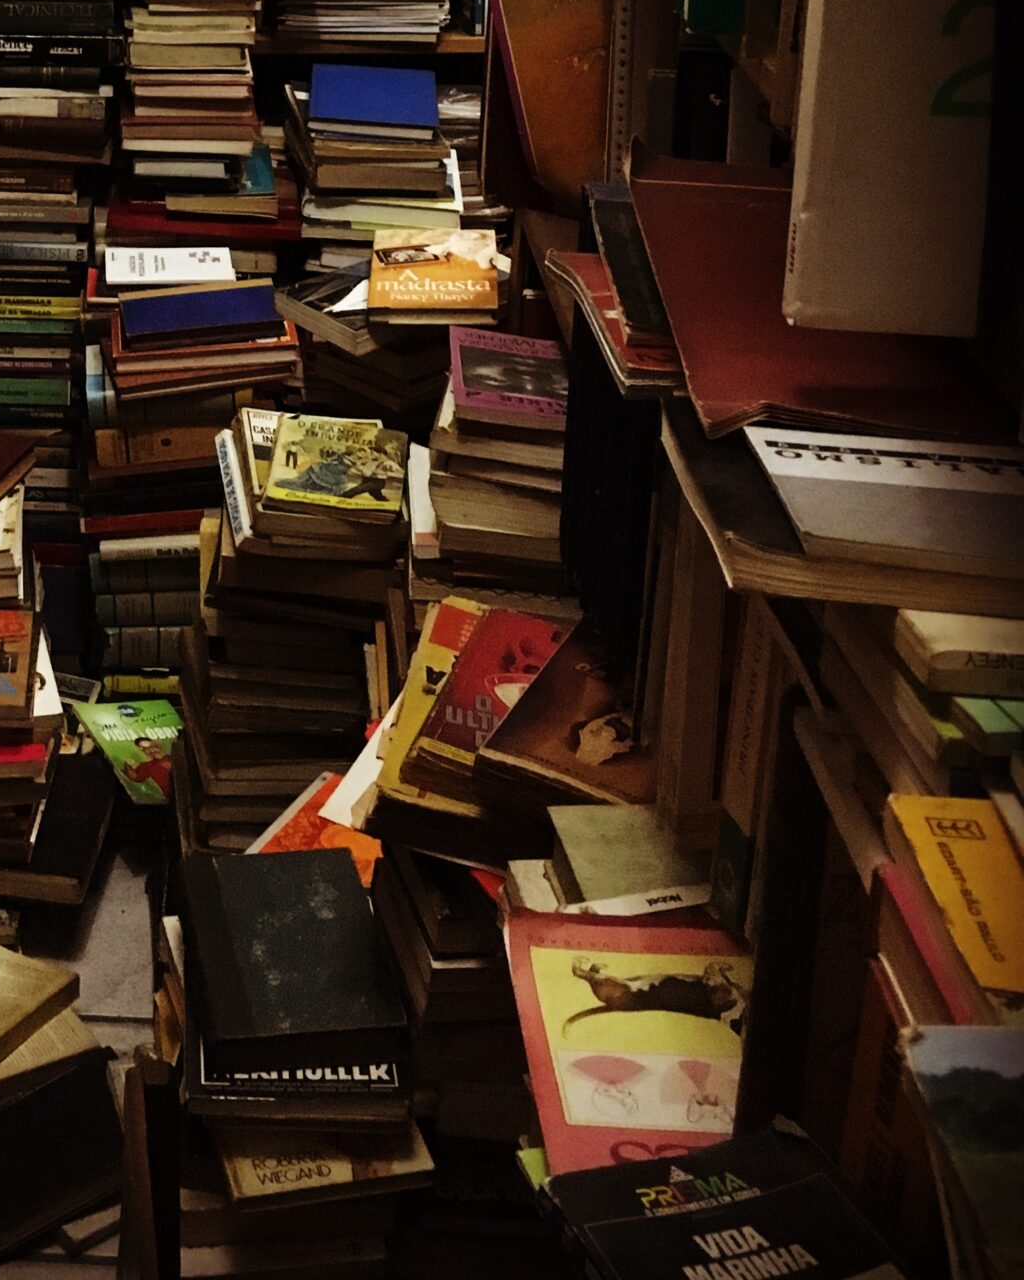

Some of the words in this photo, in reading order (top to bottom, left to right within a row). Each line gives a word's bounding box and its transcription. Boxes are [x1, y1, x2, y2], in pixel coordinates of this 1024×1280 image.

[4, 2, 95, 18] TECHNICAL
[376, 277, 491, 292] madrasta
[774, 451, 1024, 479] ALISMO
[256, 1163, 332, 1186] WIEGAND
[692, 1224, 772, 1261] VIDA
[681, 1243, 820, 1280] MARINHA
